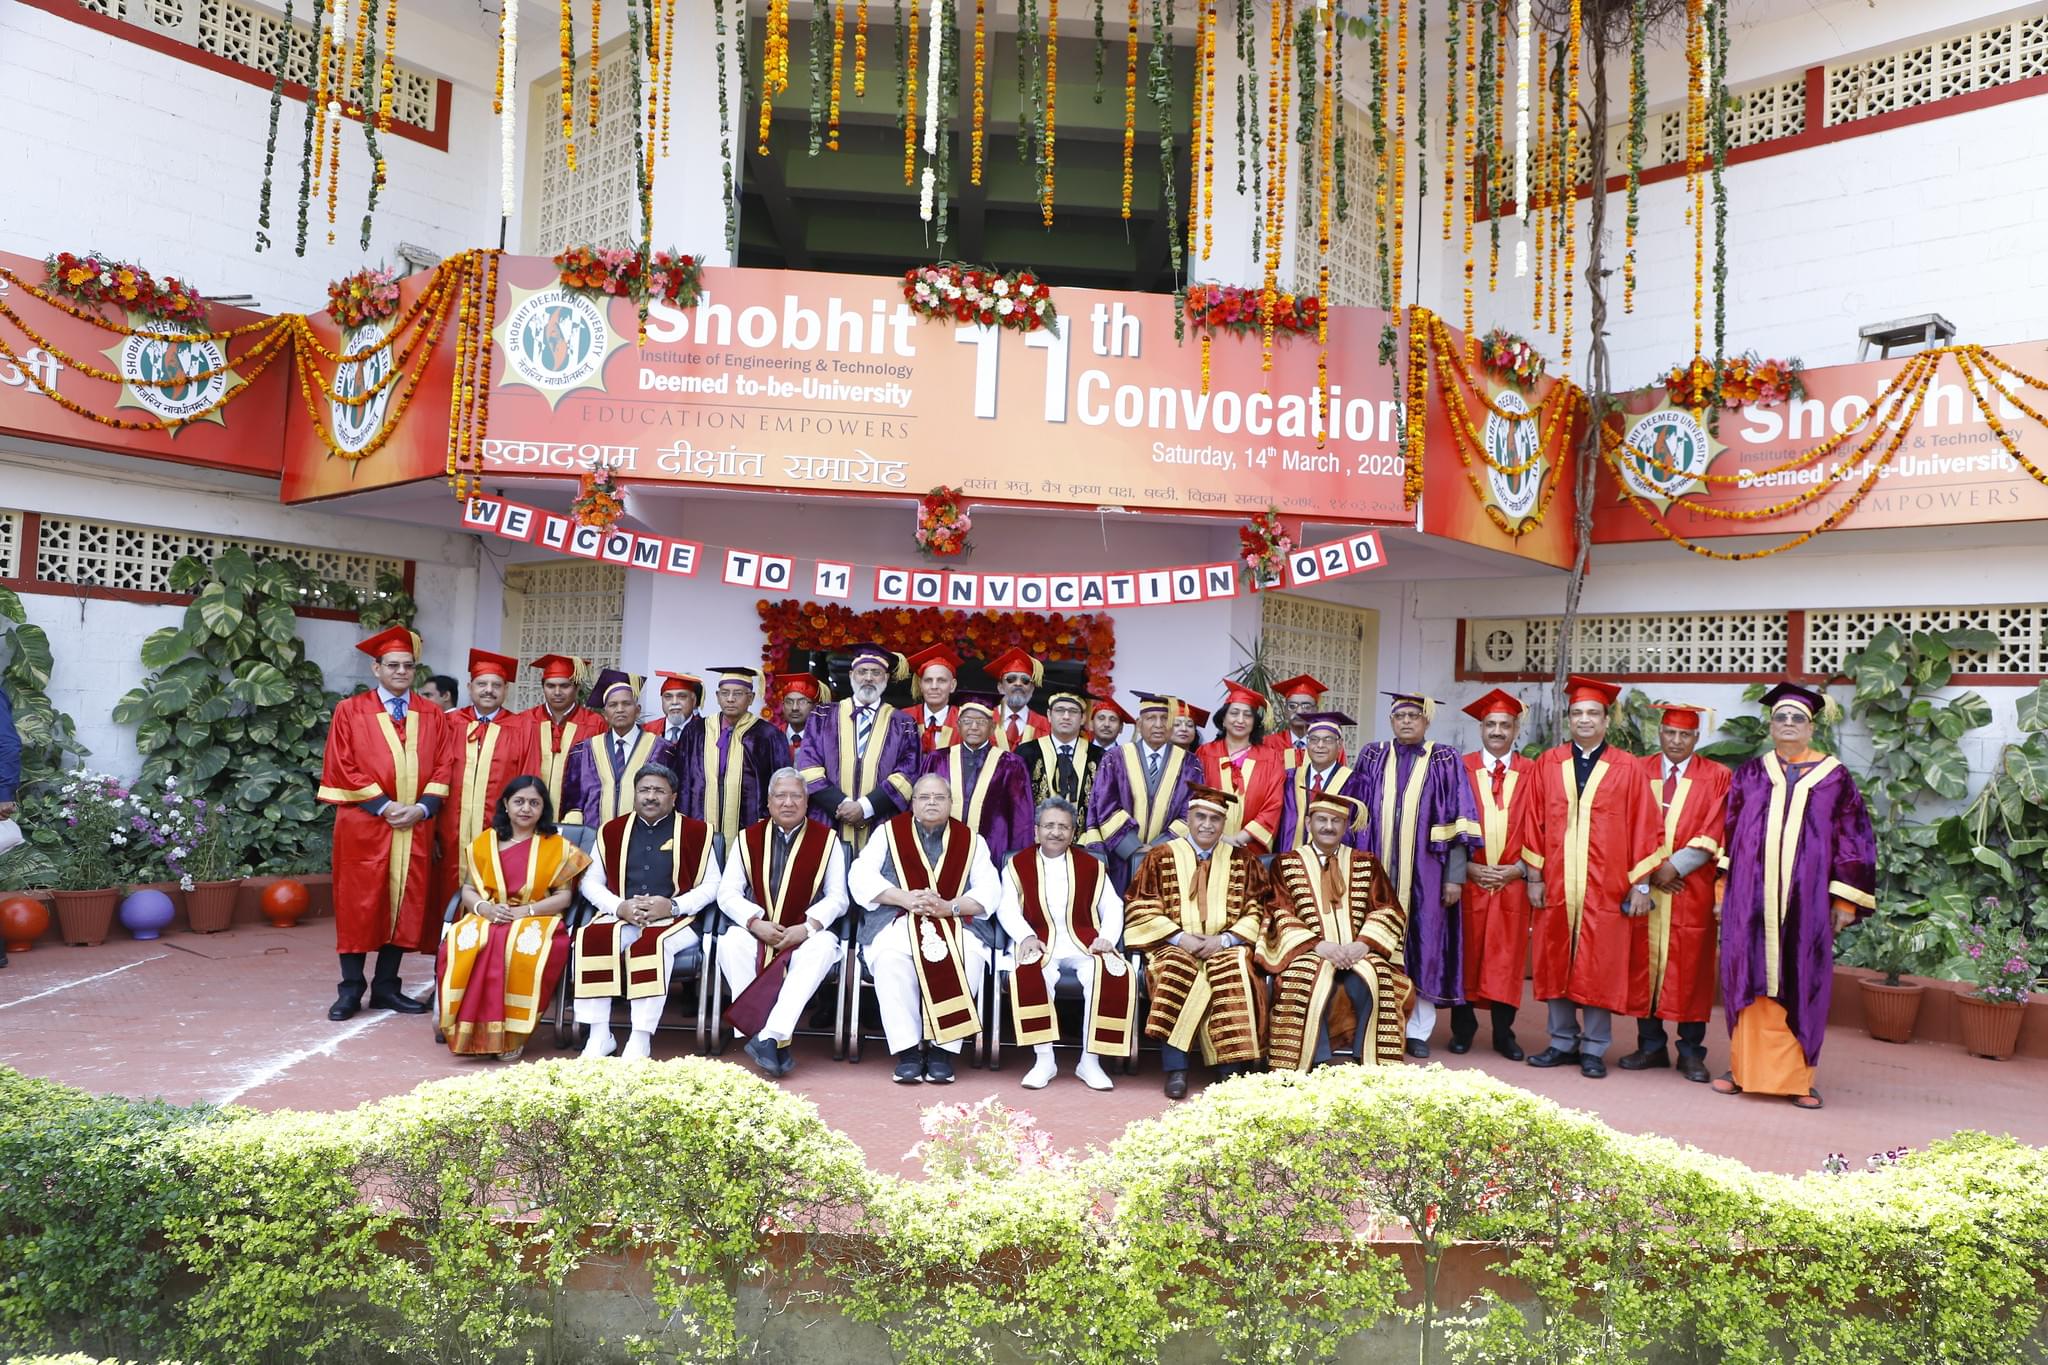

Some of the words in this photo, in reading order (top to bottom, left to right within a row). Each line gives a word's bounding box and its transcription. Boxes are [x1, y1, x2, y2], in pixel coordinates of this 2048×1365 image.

[510, 305, 530, 352] SHOBHIT
[530, 293, 576, 309] DEEMED
[576, 299, 605, 358] UNIVERSITY
[644, 290, 917, 357] Shobhit
[640, 349, 701, 365] Institute
[706, 352, 721, 366] of
[725, 353, 811, 373] Engineering
[816, 359, 828, 372] &
[832, 360, 914, 381] Technology
[639, 369, 728, 394] Deemed
[736, 376, 912, 408] to-be-University
[1076, 369, 1407, 443] Convocation
[583, 405, 745, 430] EDUCATION
[760, 415, 909, 440] EMPOWERS
[1640, 413, 1679, 431] DEEMED
[1680, 416, 1707, 465] UNIVERSITY
[656, 439, 767, 478] दीक्षांत
[782, 449, 909, 489] समारोह
[1152, 441, 1236, 471] Saturday,
[1282, 450, 1340, 473] March
[1358, 453, 1405, 477] 2020
[1740, 449, 1796, 463] Institute
[1913, 435, 1926, 449] &
[1738, 463, 1823, 489] Deemed
[1857, 487, 2020, 513] EMPOWERS
[471, 501, 691, 569] WELCOME
[733, 556, 786, 583] TO
[820, 571, 847, 590] 11
[1264, 541, 1372, 582] 020
